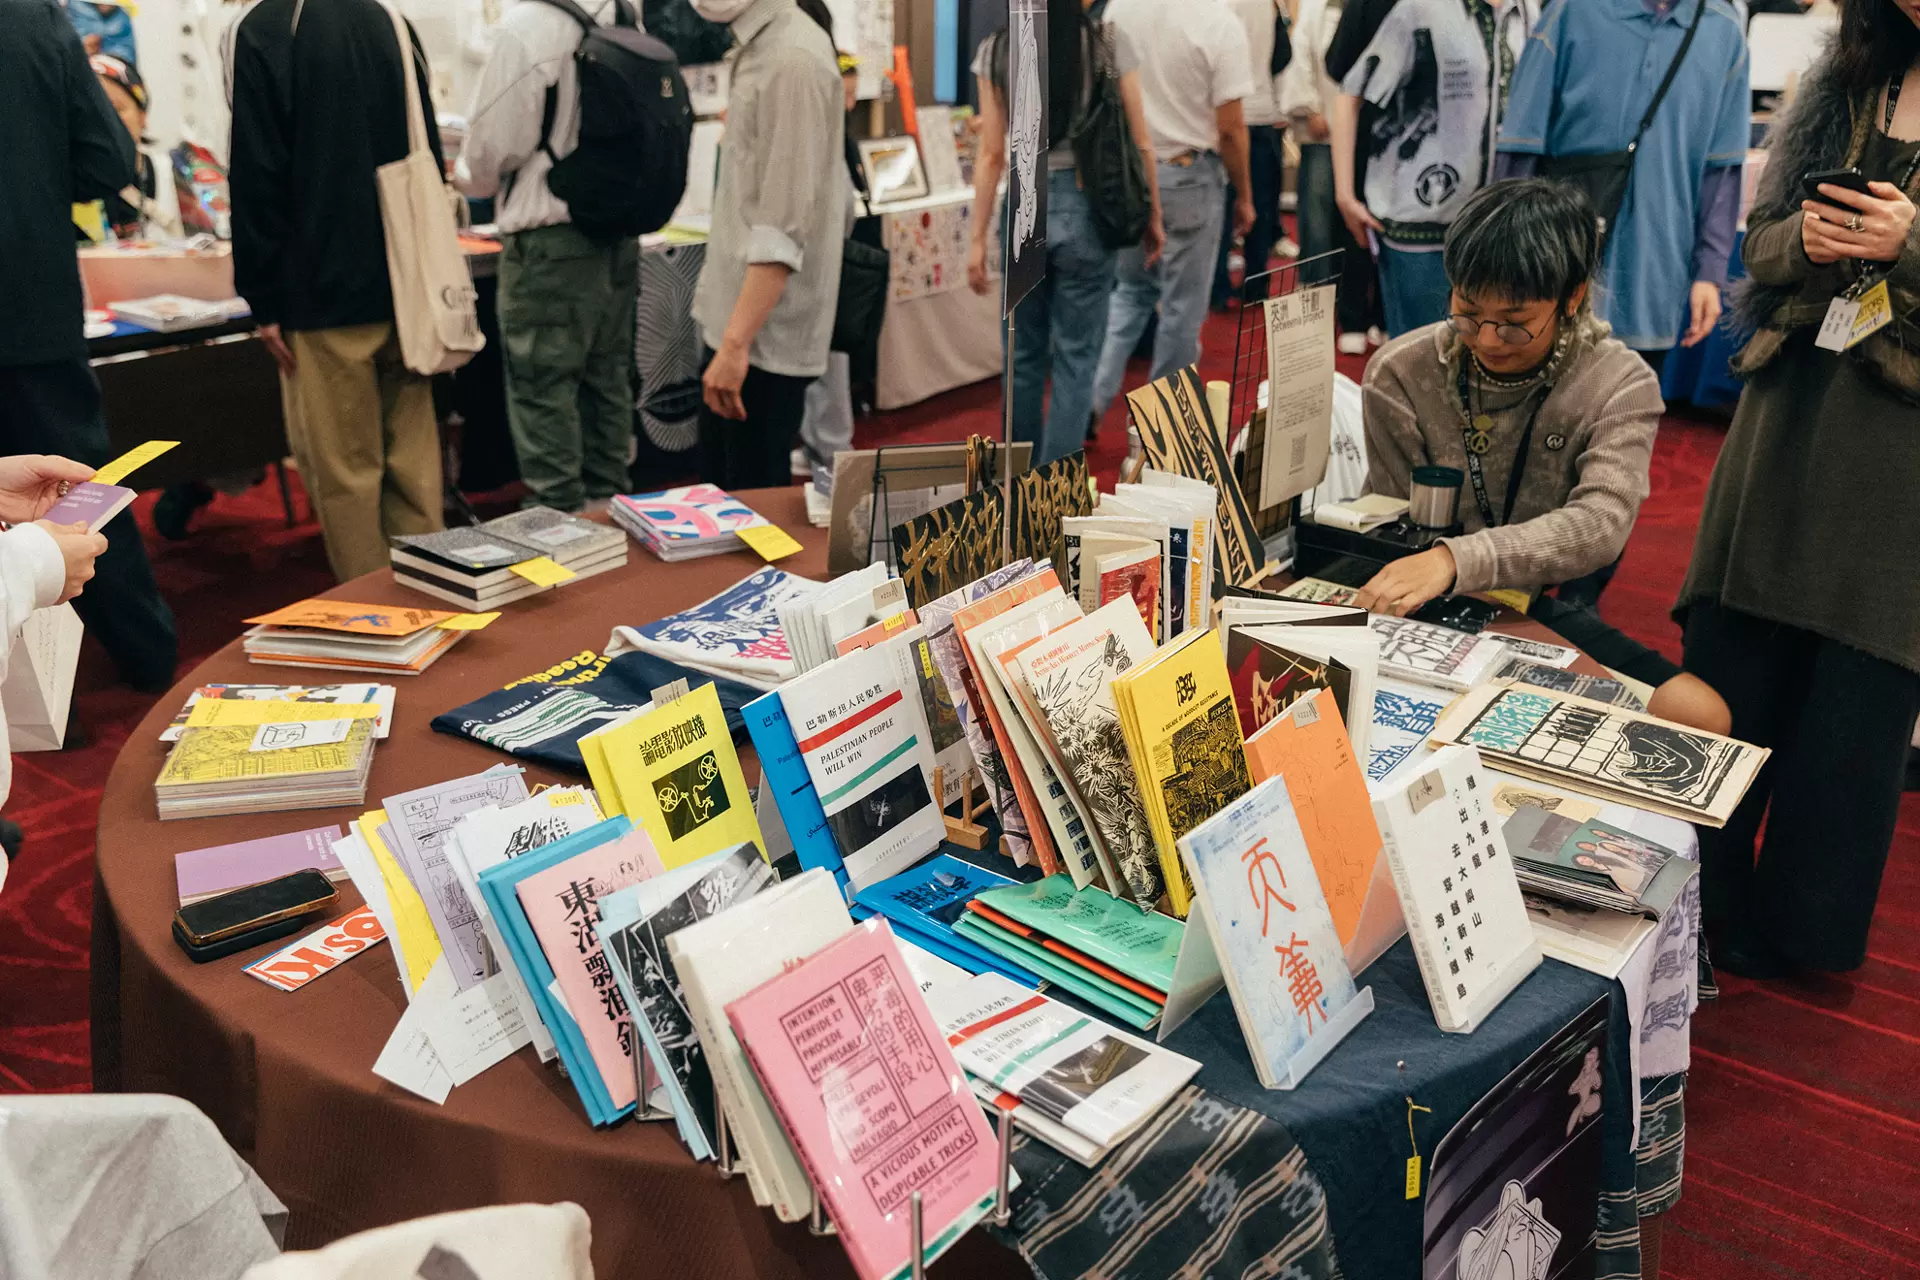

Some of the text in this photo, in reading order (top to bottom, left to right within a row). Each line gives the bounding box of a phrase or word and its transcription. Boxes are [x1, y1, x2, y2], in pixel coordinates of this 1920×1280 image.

[496, 700, 532, 718] PRESS
[820, 717, 895, 765] PALESTINIAN PEOPLE
[824, 749, 863, 776] WILL WIN
[786, 994, 836, 1031] INTENTION
[868, 1101, 898, 1127] SCOPO
[870, 1112, 964, 1189] A VICIOUS MOTIVE,
[879, 1128, 974, 1210] DESPICABLE TRICKS
